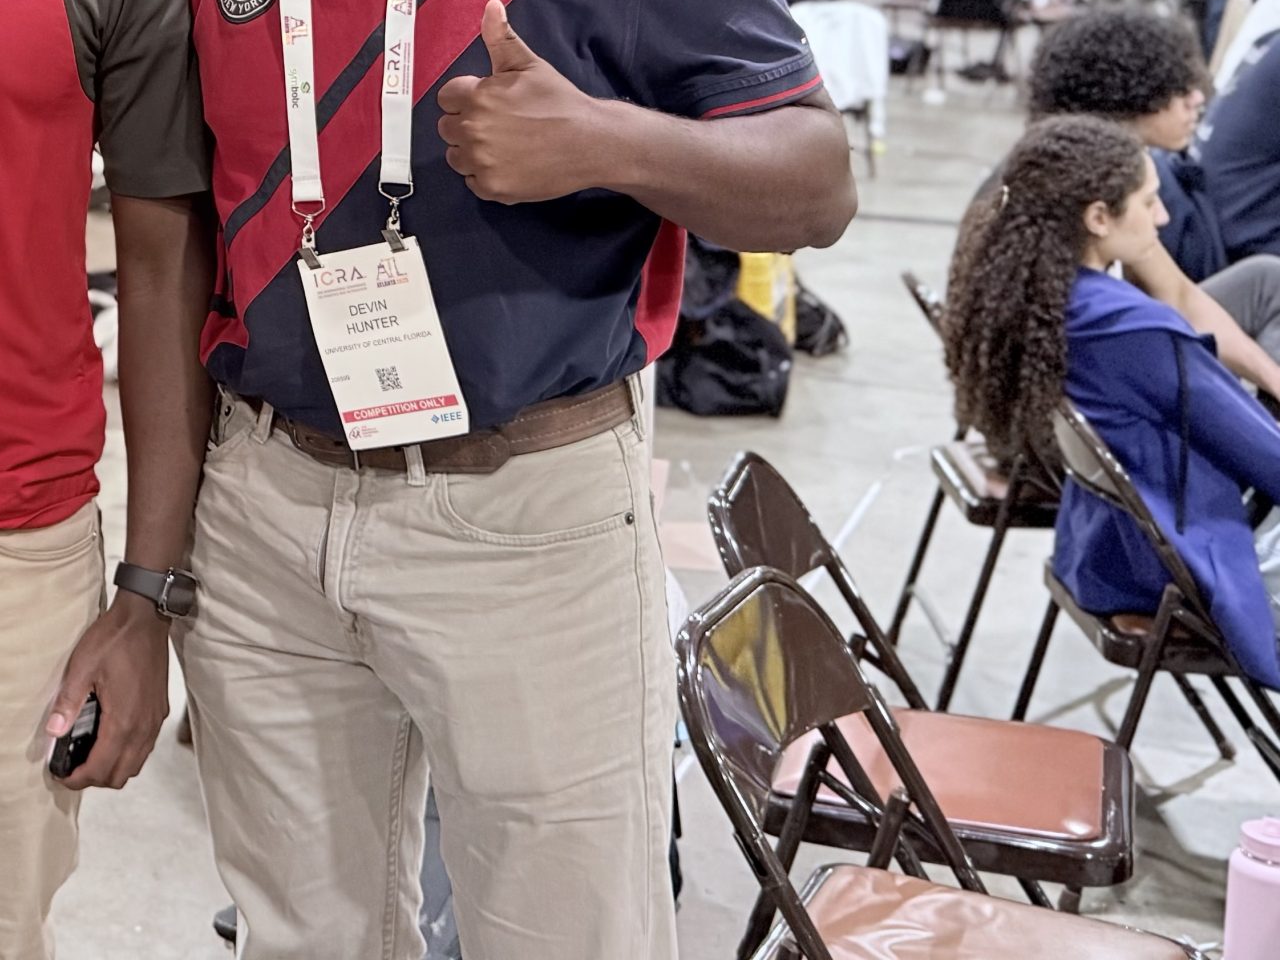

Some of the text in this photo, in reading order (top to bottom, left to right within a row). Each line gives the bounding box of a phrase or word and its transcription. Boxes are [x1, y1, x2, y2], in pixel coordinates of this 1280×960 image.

[385, 41, 401, 94] ICRA
[314, 266, 365, 288] ICRA
[349, 299, 388, 317] DEVIN
[346, 315, 400, 335] HUNTER
[325, 330, 432, 355] UNIVERSITY OF CENTRAL FLORIDA
[353, 397, 446, 420] COMPETITION ONLY
[440, 411, 463, 423] IEEE
